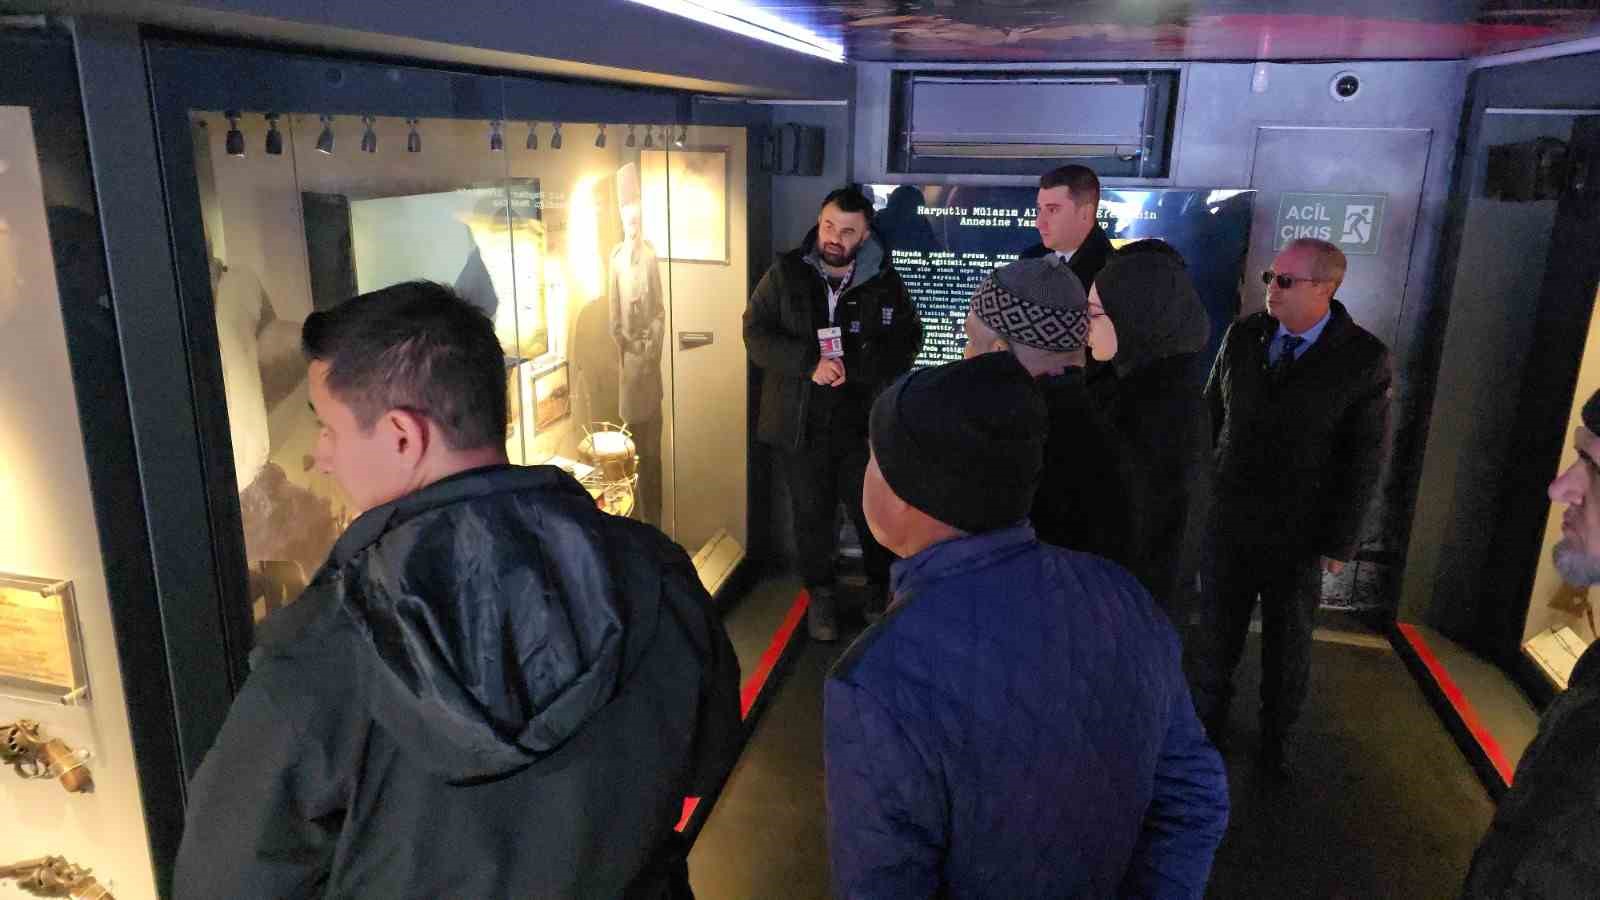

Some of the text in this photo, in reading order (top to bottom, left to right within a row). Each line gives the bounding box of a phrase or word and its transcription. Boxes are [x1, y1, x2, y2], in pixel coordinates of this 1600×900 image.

[917, 206, 967, 216] Harputlu
[1286, 202, 1330, 221] ACİL
[960, 217, 1011, 226] Annesine
